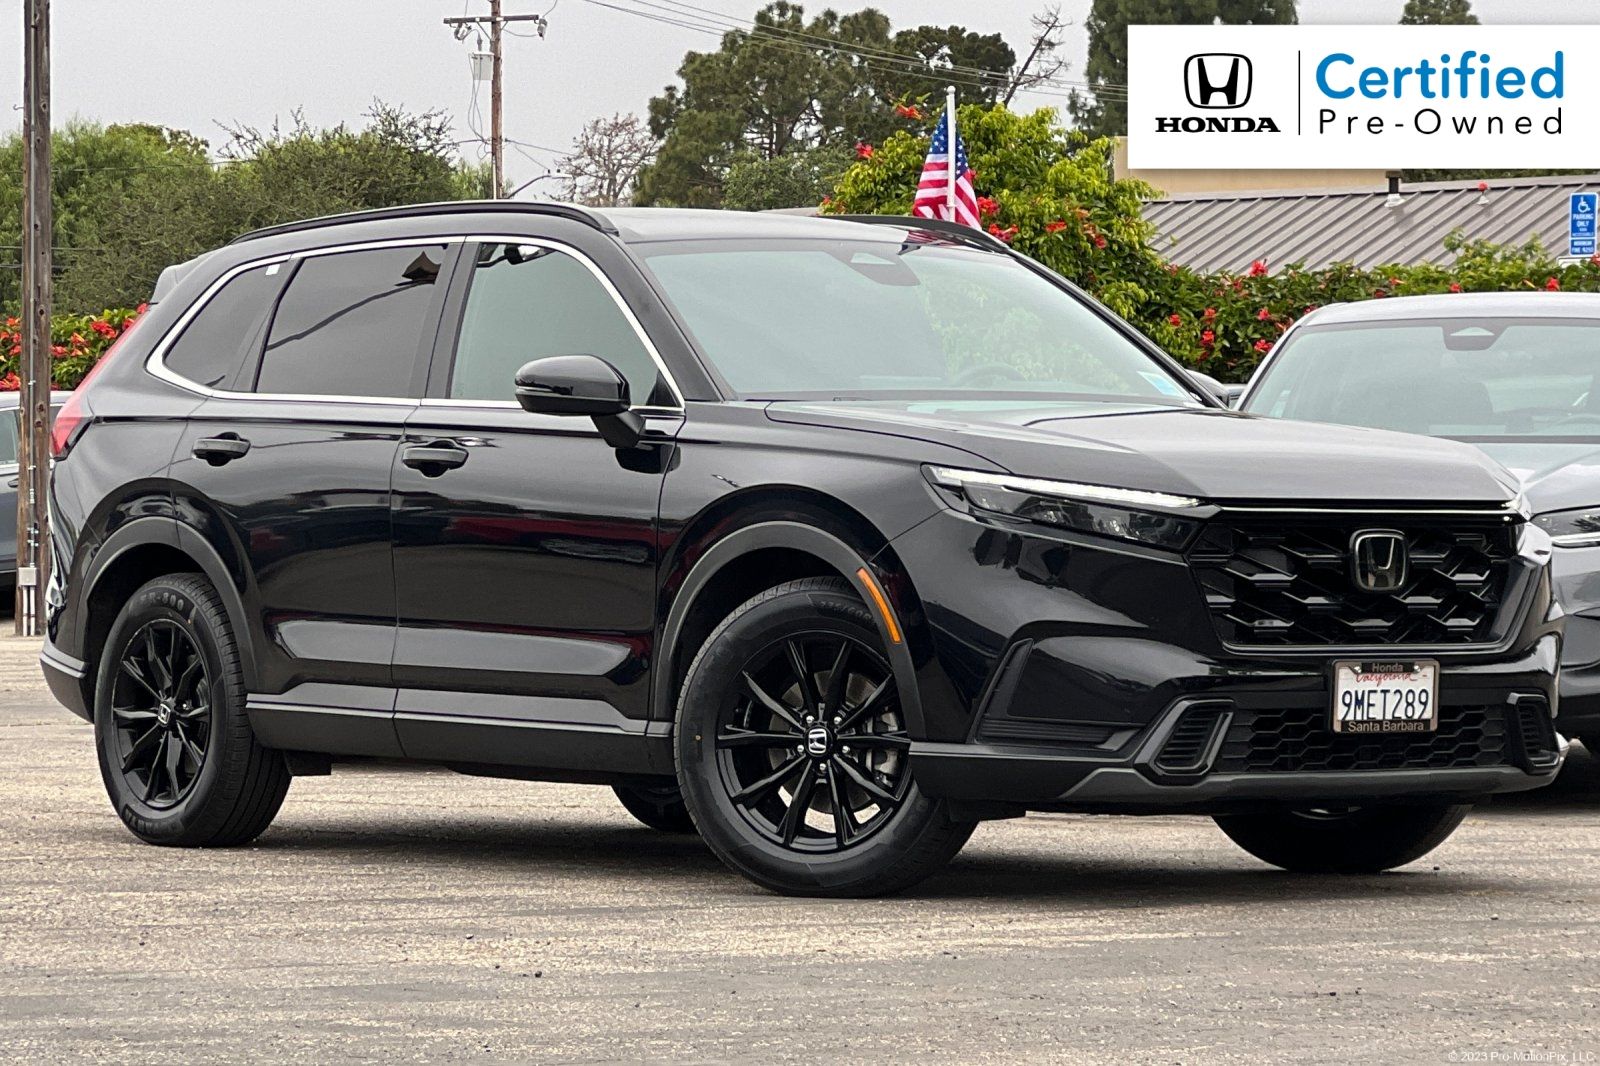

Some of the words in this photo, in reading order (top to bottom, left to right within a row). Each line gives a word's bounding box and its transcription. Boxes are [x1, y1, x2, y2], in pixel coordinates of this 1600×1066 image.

[1371, 663, 1404, 673] Honda
[1341, 688, 1429, 720] 9MET289
[1348, 721, 1380, 732] Santa
[1382, 720, 1425, 732] Barbara
